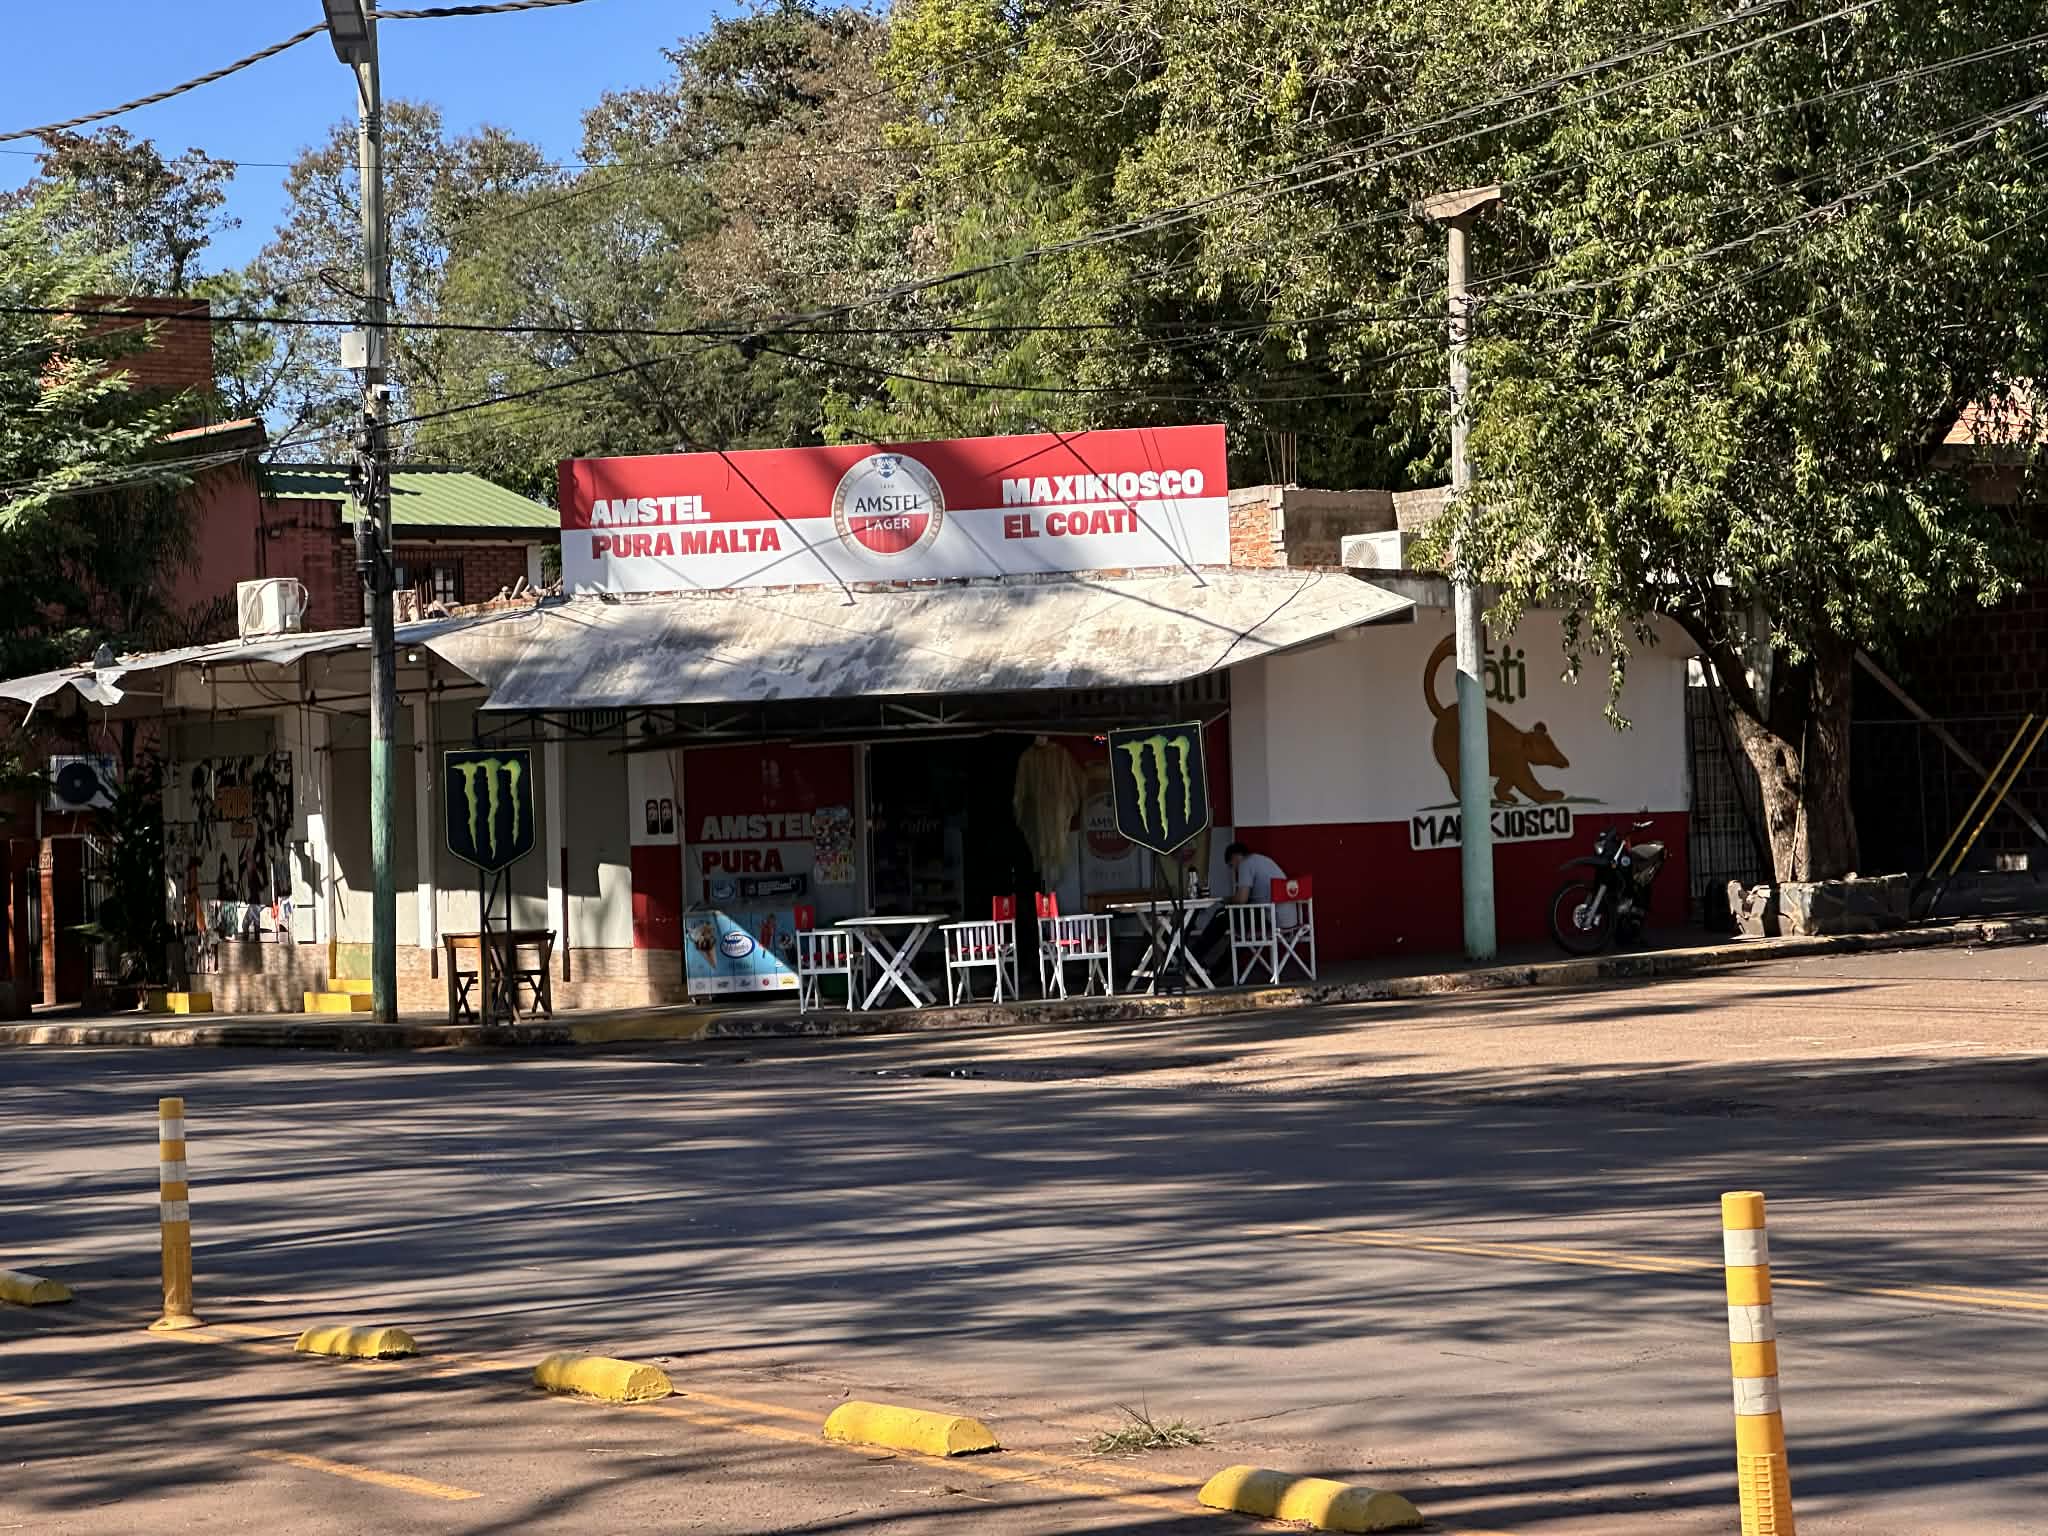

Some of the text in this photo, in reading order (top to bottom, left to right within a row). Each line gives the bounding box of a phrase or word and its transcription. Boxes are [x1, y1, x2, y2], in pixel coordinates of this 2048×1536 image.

[1002, 469, 1204, 504] MAXIKIOSCO
[590, 495, 711, 526] AMSTEL
[855, 493, 923, 513] AMSTEL
[865, 518, 911, 531] LAGER
[1004, 514, 1040, 539] EL
[591, 528, 782, 559] PURA MALTA
[703, 850, 783, 874] PURA
